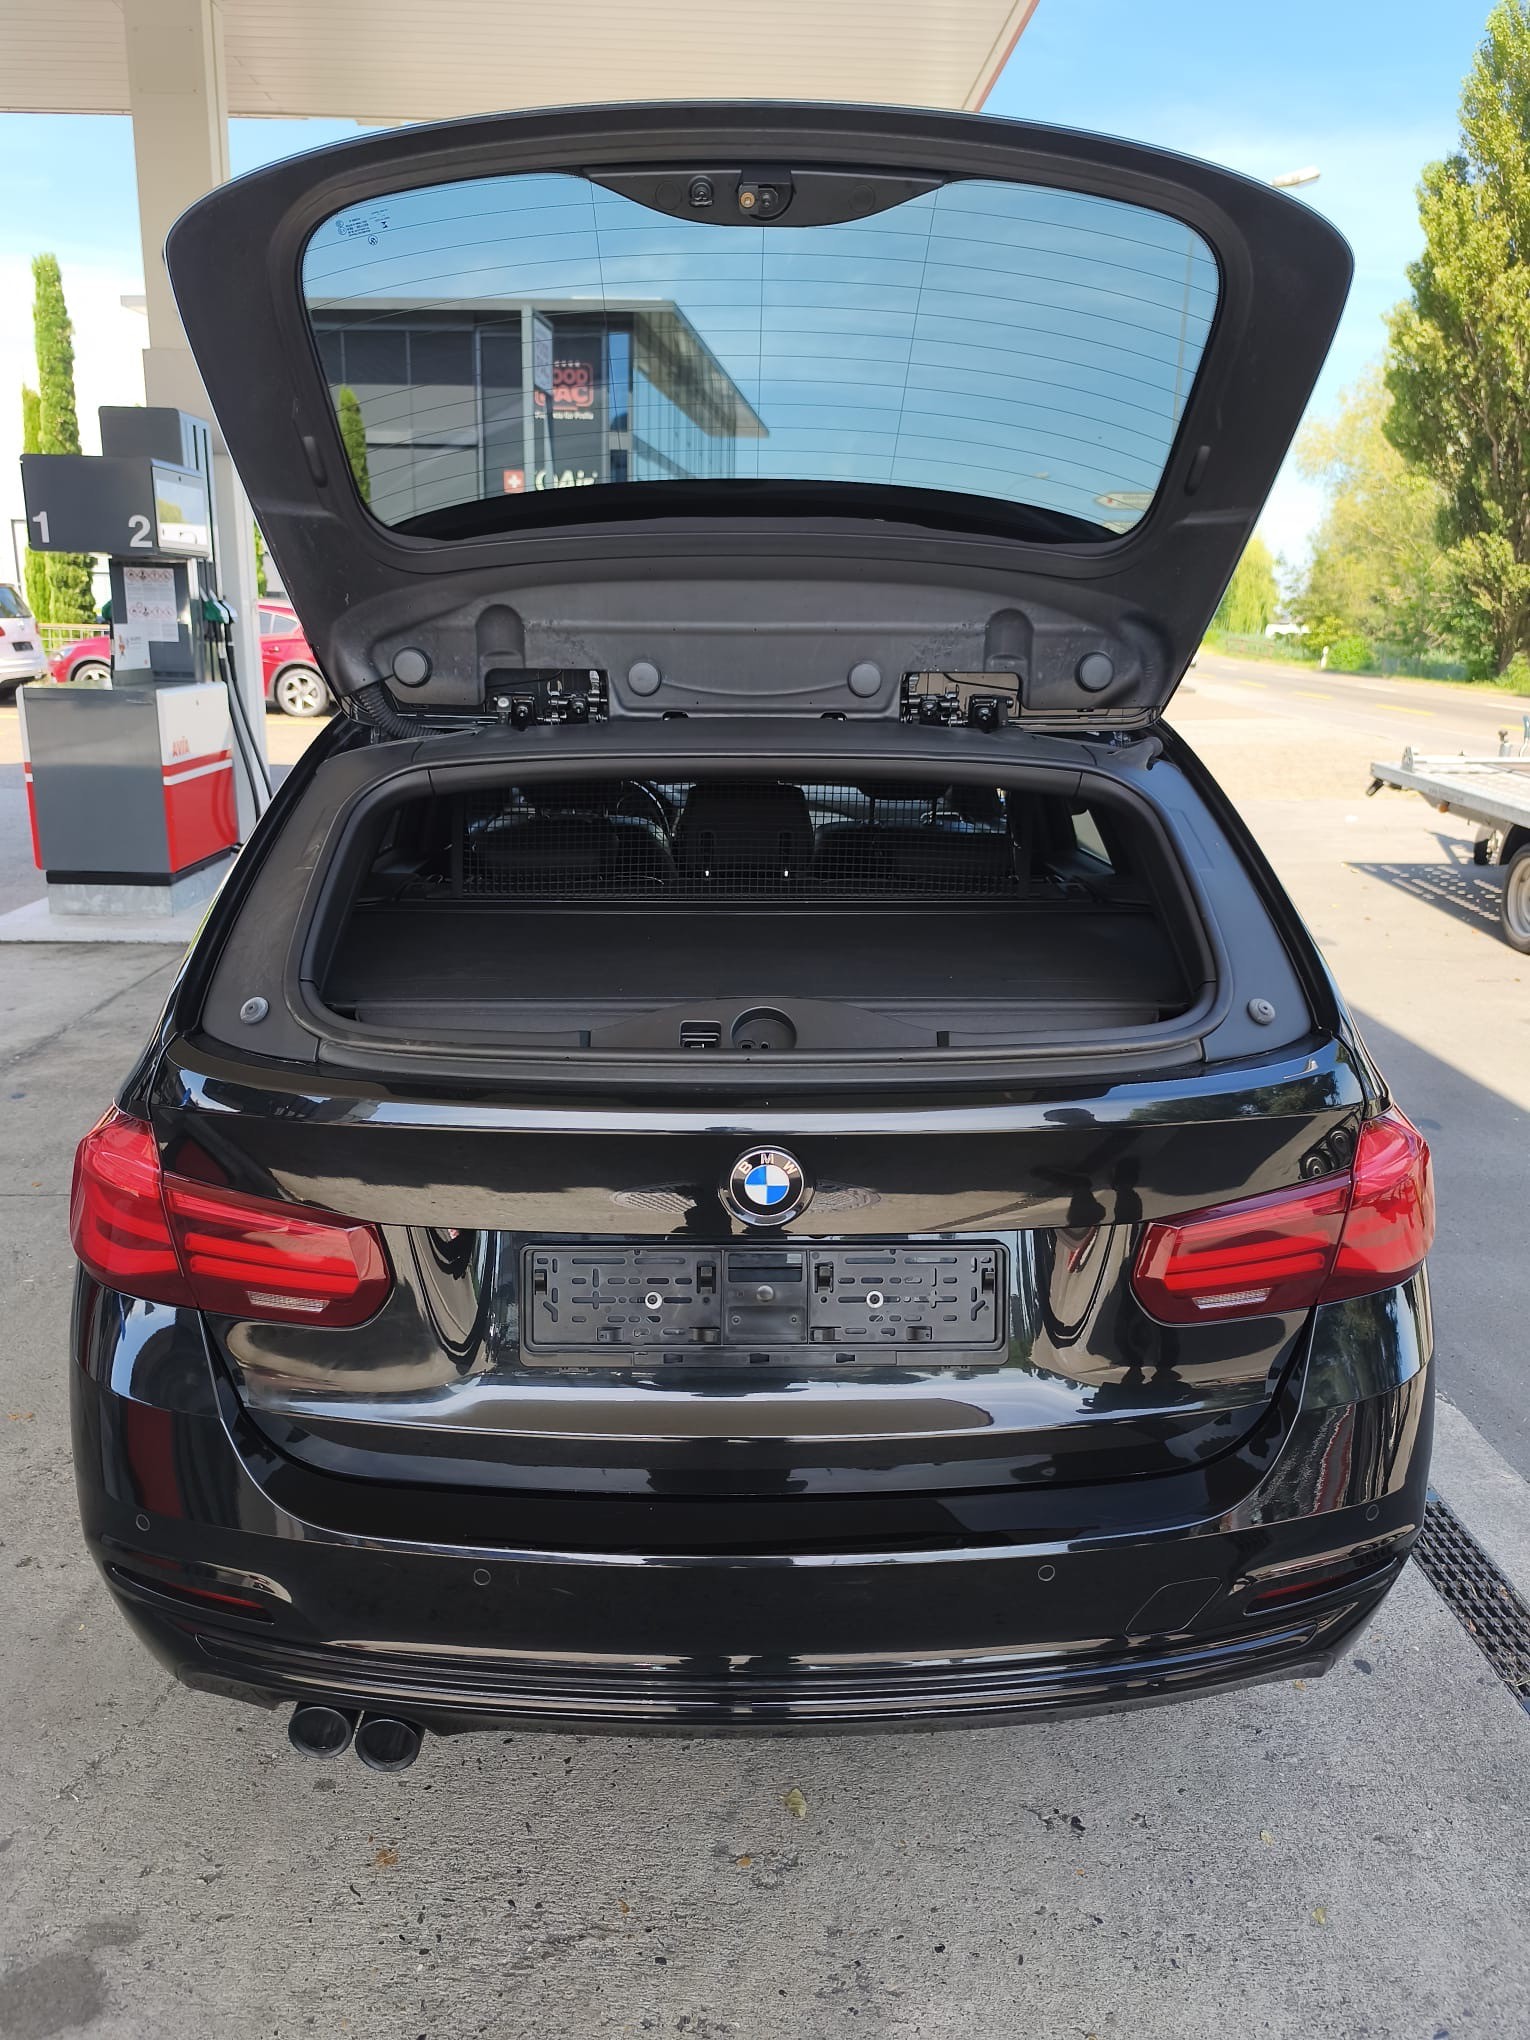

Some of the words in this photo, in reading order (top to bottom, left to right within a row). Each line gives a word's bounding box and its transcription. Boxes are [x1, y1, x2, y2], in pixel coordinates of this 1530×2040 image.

[32, 511, 50, 543] 1
[128, 514, 153, 548] 2
[737, 1153, 798, 1175] BMW
